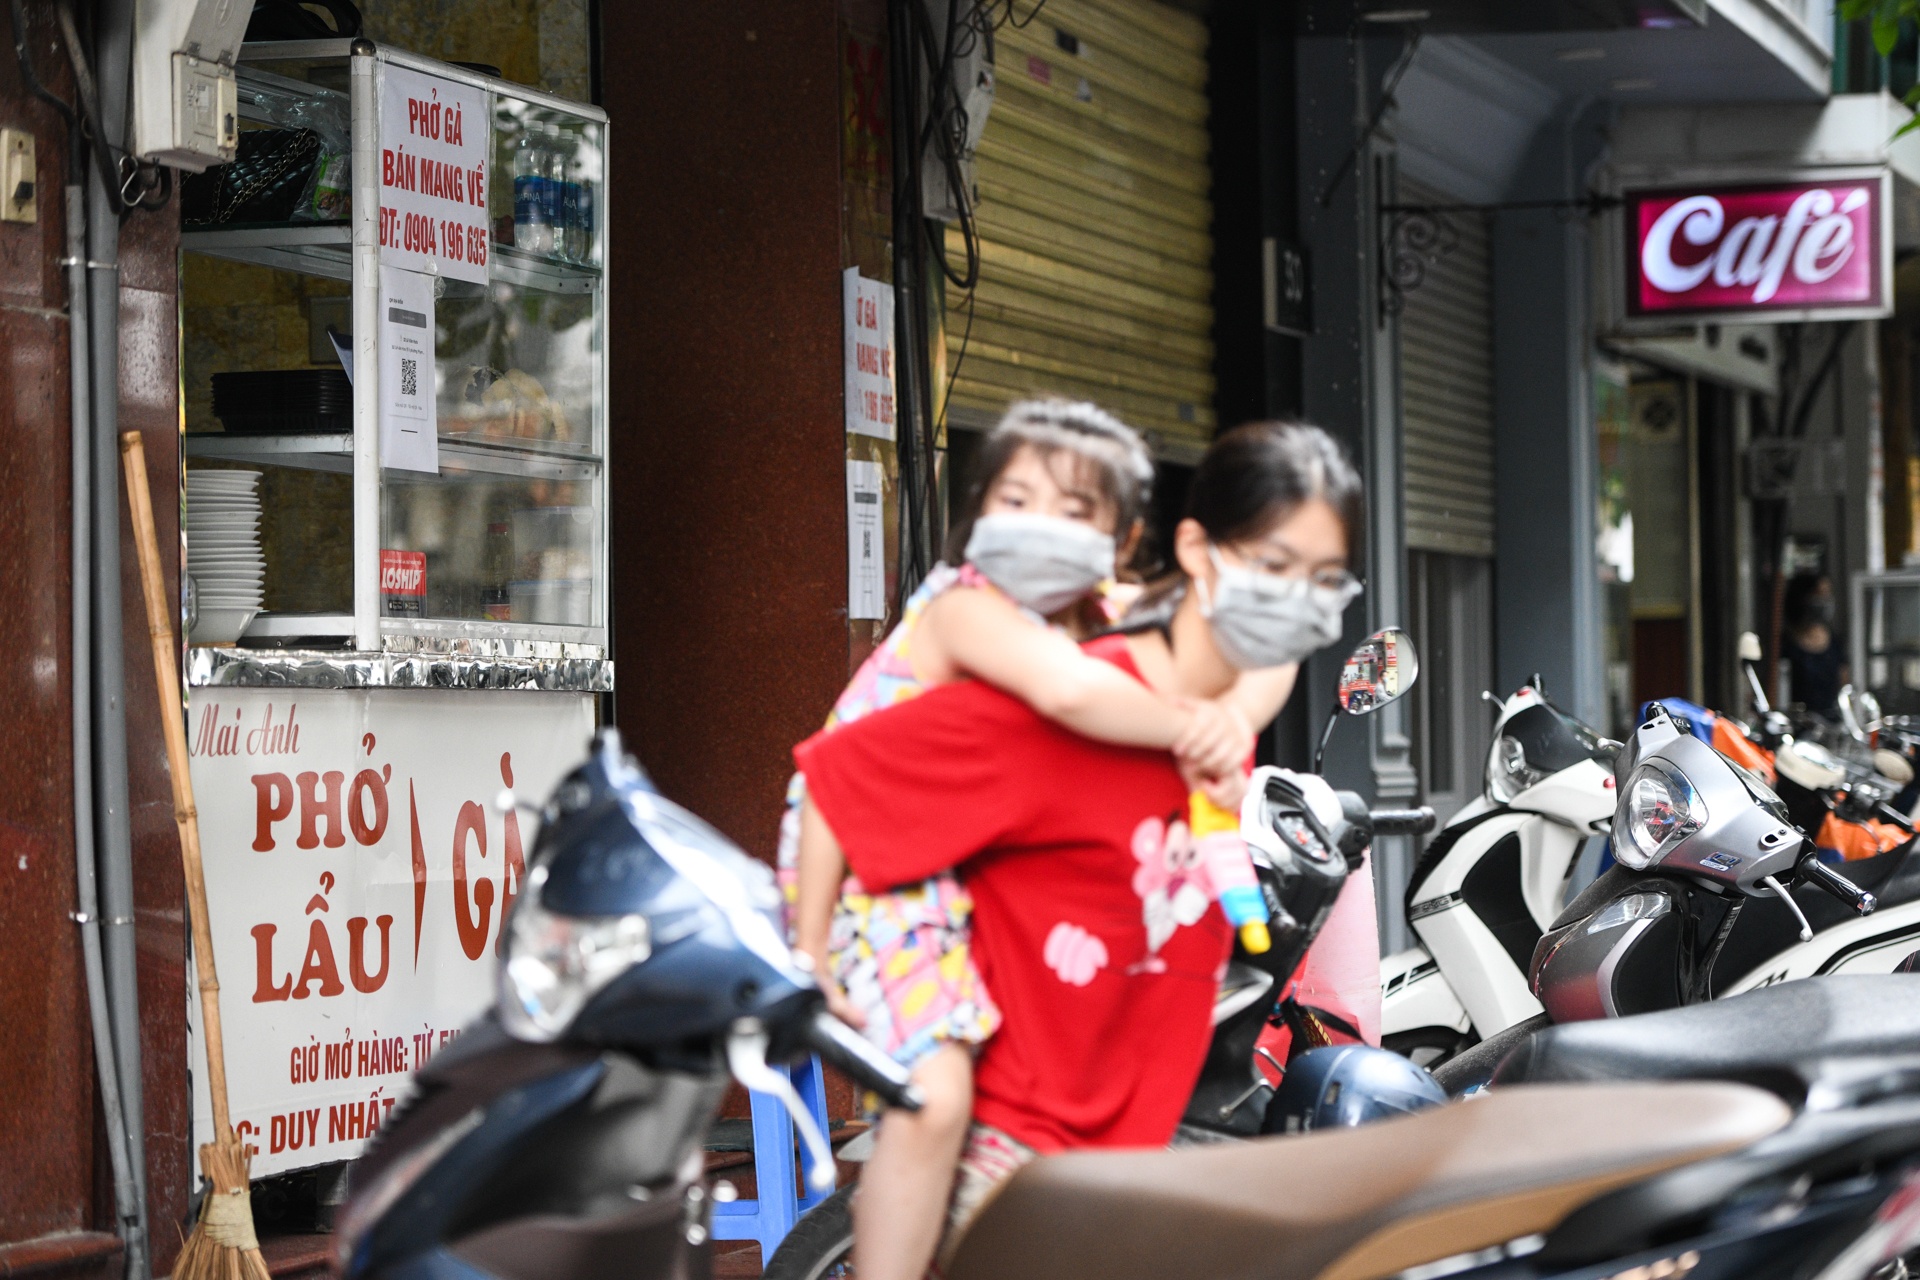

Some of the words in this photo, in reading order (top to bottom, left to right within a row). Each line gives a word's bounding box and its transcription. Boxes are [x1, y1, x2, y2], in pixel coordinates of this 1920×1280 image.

[408, 87, 441, 141] PHỞ
[444, 101, 463, 147] GÀ
[383, 144, 416, 192] BÁN
[420, 157, 464, 204] MANG
[467, 159, 485, 208] VỀ
[379, 206, 401, 249] ĐT:
[404, 212, 437, 256] 0904
[440, 219, 464, 262] 196
[467, 225, 487, 267] 635
[1641, 187, 1870, 303] Café
[382, 567, 424, 590] LOSHIP
[189, 702, 241, 758] Mai
[246, 702, 301, 757] Anh
[250, 732, 392, 853] PHỞ
[452, 751, 527, 961] GÀ
[250, 871, 394, 1004] LẨU
[290, 1035, 321, 1085] GIỜ
[324, 1027, 354, 1081] MỞ
[357, 1030, 408, 1078] HÀNG:
[413, 1022, 434, 1072] TỪ
[270, 1107, 321, 1155] DUY
